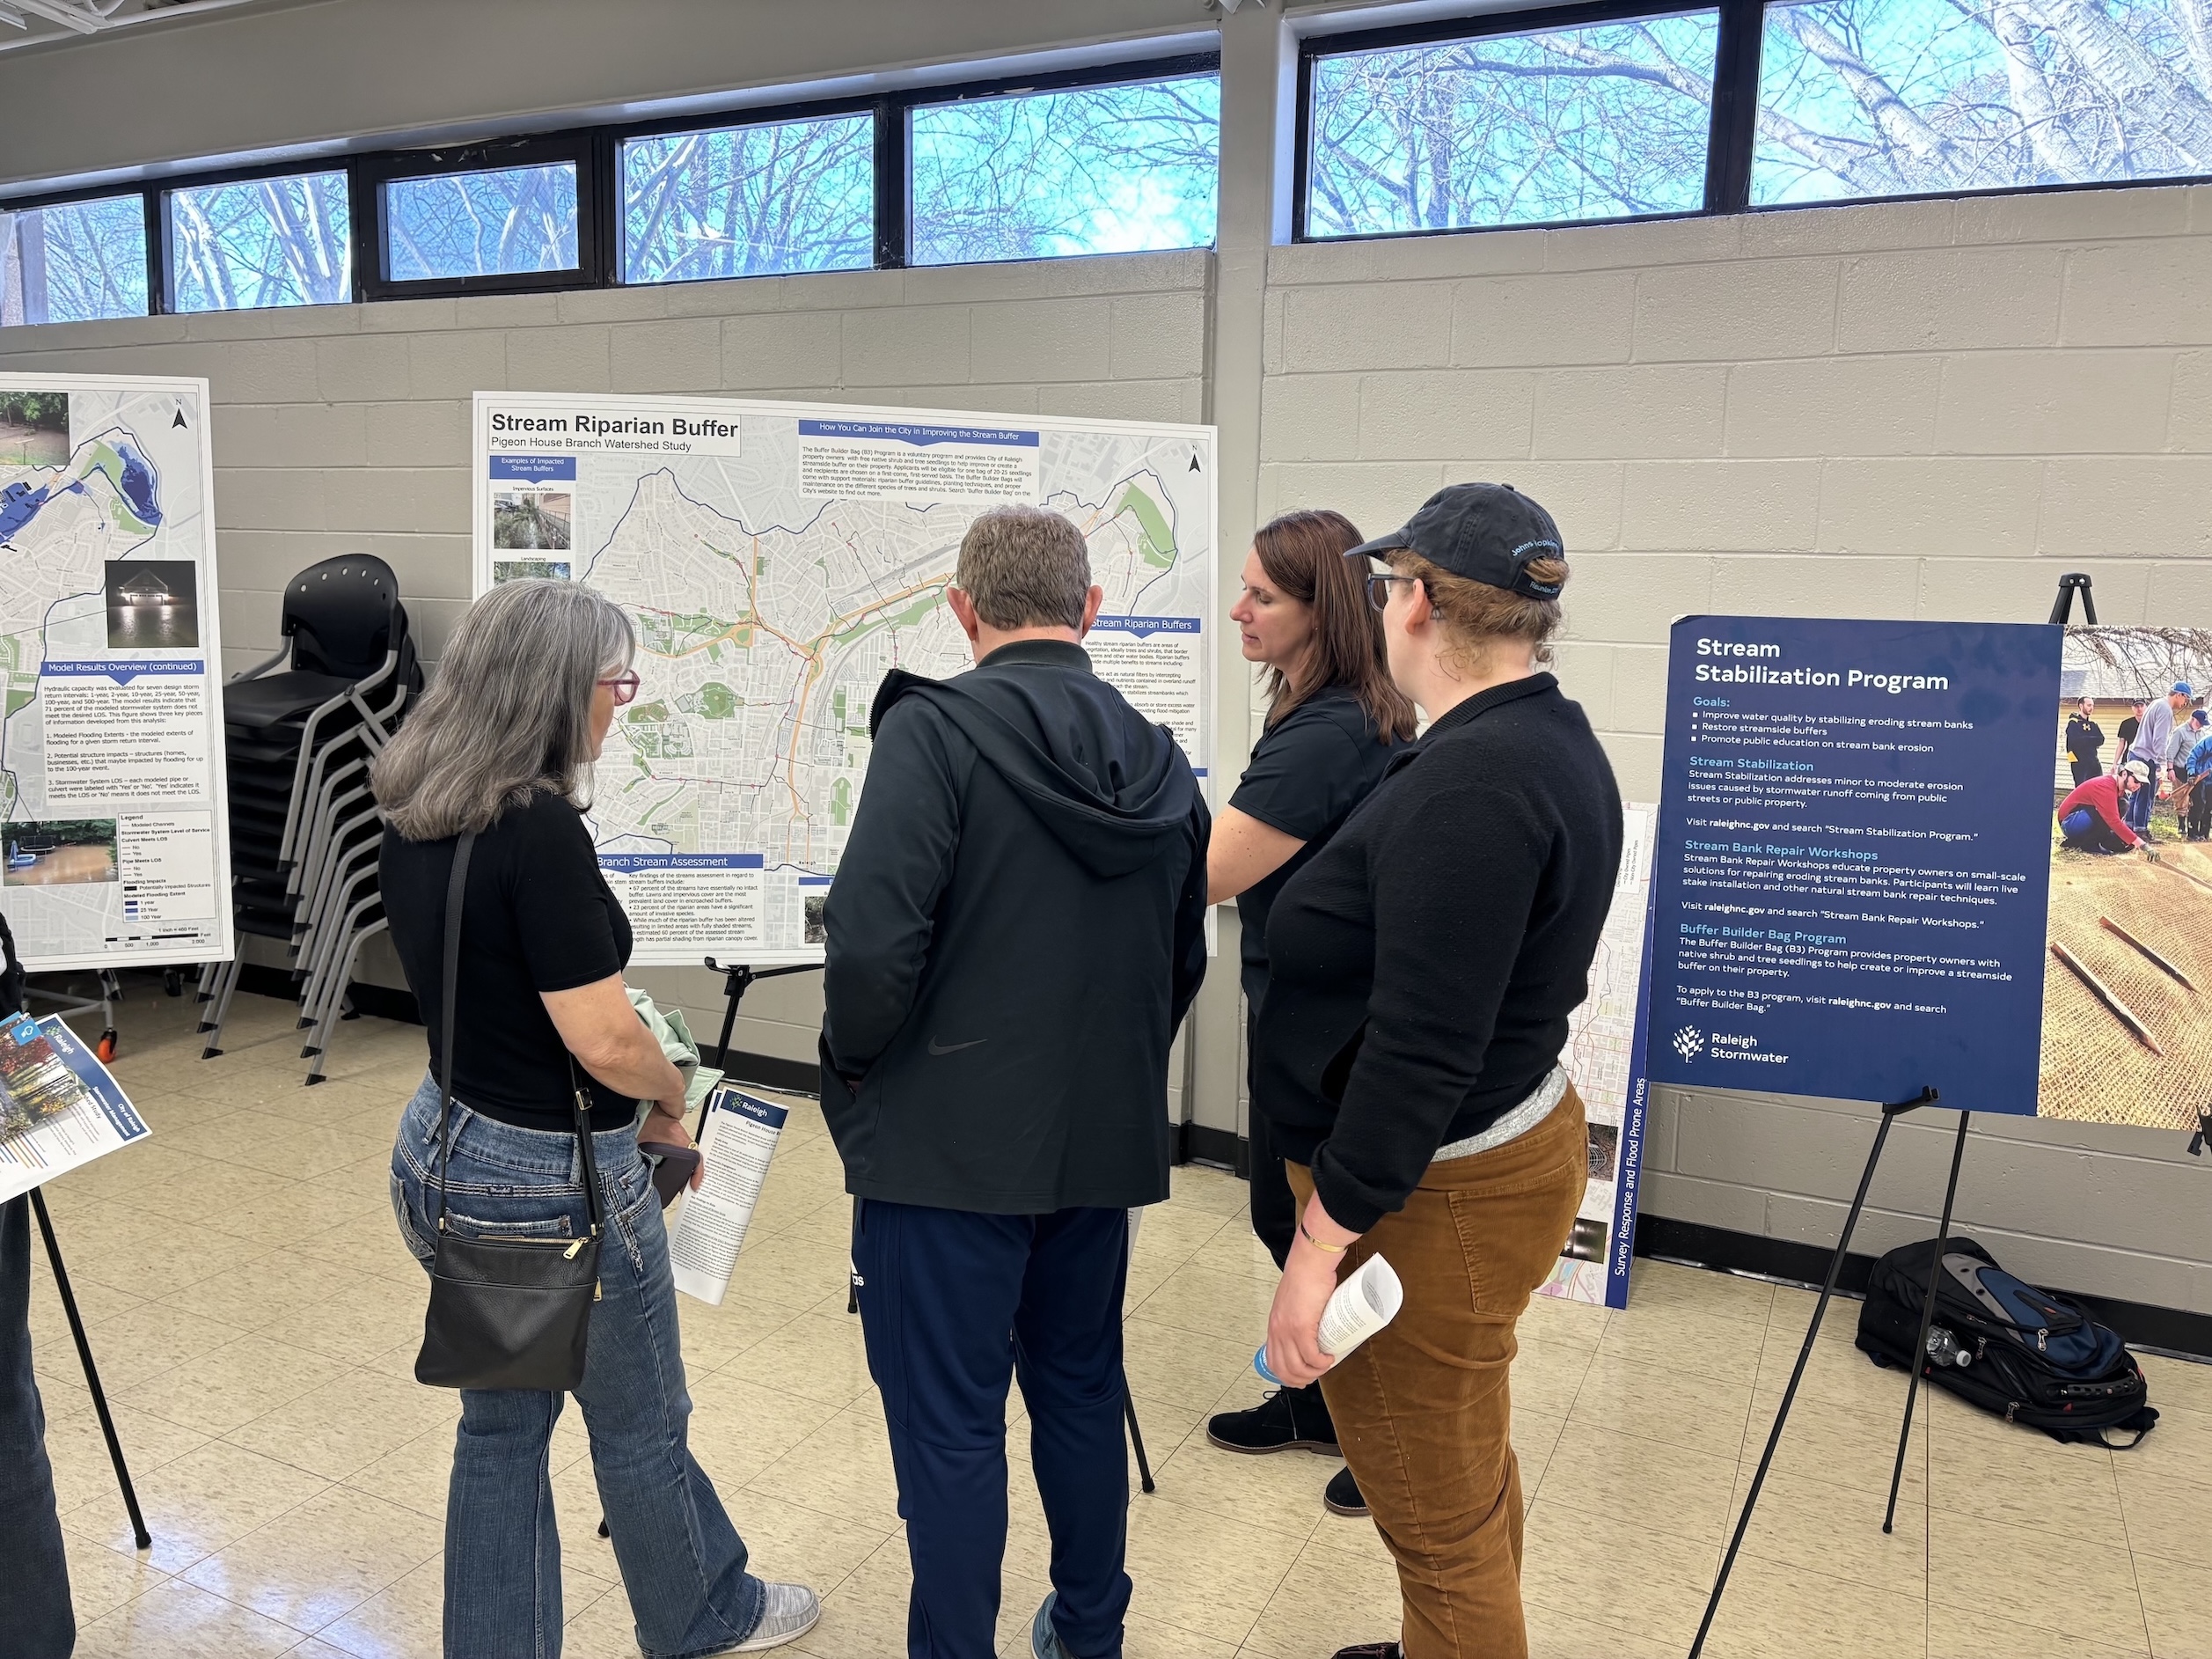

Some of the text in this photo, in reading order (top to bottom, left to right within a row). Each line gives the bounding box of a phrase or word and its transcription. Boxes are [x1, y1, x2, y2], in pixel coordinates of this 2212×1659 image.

[492, 414, 739, 437] Stream Riparian Buffer
[819, 422, 836, 431] How
[852, 423, 868, 432] Can
[868, 424, 883, 433] Join
[897, 426, 912, 436] City
[922, 428, 957, 439] Improving
[958, 429, 971, 438] the
[972, 430, 997, 439] Stream
[998, 431, 1020, 440] Buffer
[491, 437, 692, 453] Pigeon House Branch Watershed Study
[1529, 581, 1552, 594] Reunion
[1091, 618, 1192, 630] Stream Riparian Buffers
[1696, 637, 1780, 657] Stream
[48, 662, 197, 672] Model Results Overview (continued)
[1695, 664, 1949, 694] Stabilization Program
[1693, 696, 1730, 708] Goals:
[1702, 722, 1827, 736] Restore streamside buffers
[1703, 710, 1740, 721] Improve
[1770, 714, 1804, 724] quality
[1805, 714, 1817, 724] by
[1818, 715, 1866, 728] stabilizing
[1868, 717, 1905, 729] eroding
[1907, 719, 1942, 728] stream
[1944, 719, 1974, 730] banks
[1701, 734, 1741, 745] Promote
[1743, 736, 1771, 746] public
[1772, 738, 1820, 747] education
[1835, 741, 1871, 750] stream
[1871, 741, 1896, 751] bank
[1897, 744, 1934, 752] erosion
[1689, 756, 1814, 772] Stream Stabilization
[1686, 817, 1708, 826] Visit
[1709, 818, 1770, 832] raleighnc.gov
[1771, 822, 1790, 831] and
[1791, 824, 1823, 833] search
[1865, 826, 1927, 839] Stabilization
[1685, 840, 1879, 863] Stream Bank Repair Workshops
[597, 856, 729, 867] Branch Stream Assessment
[1681, 901, 1703, 911] Visit
[1704, 902, 1766, 916] raleighnc.gov
[1767, 907, 1785, 916] and
[1786, 909, 1818, 918] search
[1861, 913, 1886, 922] Bank
[1887, 914, 1920, 926] Repair
[1680, 923, 1847, 946] Buffer Builder Bag Program
[1678, 960, 1707, 971] buffer
[1722, 964, 1746, 973] their
[1747, 967, 1790, 979] property.
[1711, 1000, 1745, 1010] Builder
[54, 1033, 74, 1055] Raleigh
[1711, 1032, 1758, 1049] Raleigh
[1710, 1046, 1789, 1064] Stormwater
[92, 1086, 131, 1137] Stormwater Management
[742, 1101, 768, 1117] Raleigh
[1614, 1077, 1645, 1277] Survey Response and Flood Prone Areas
